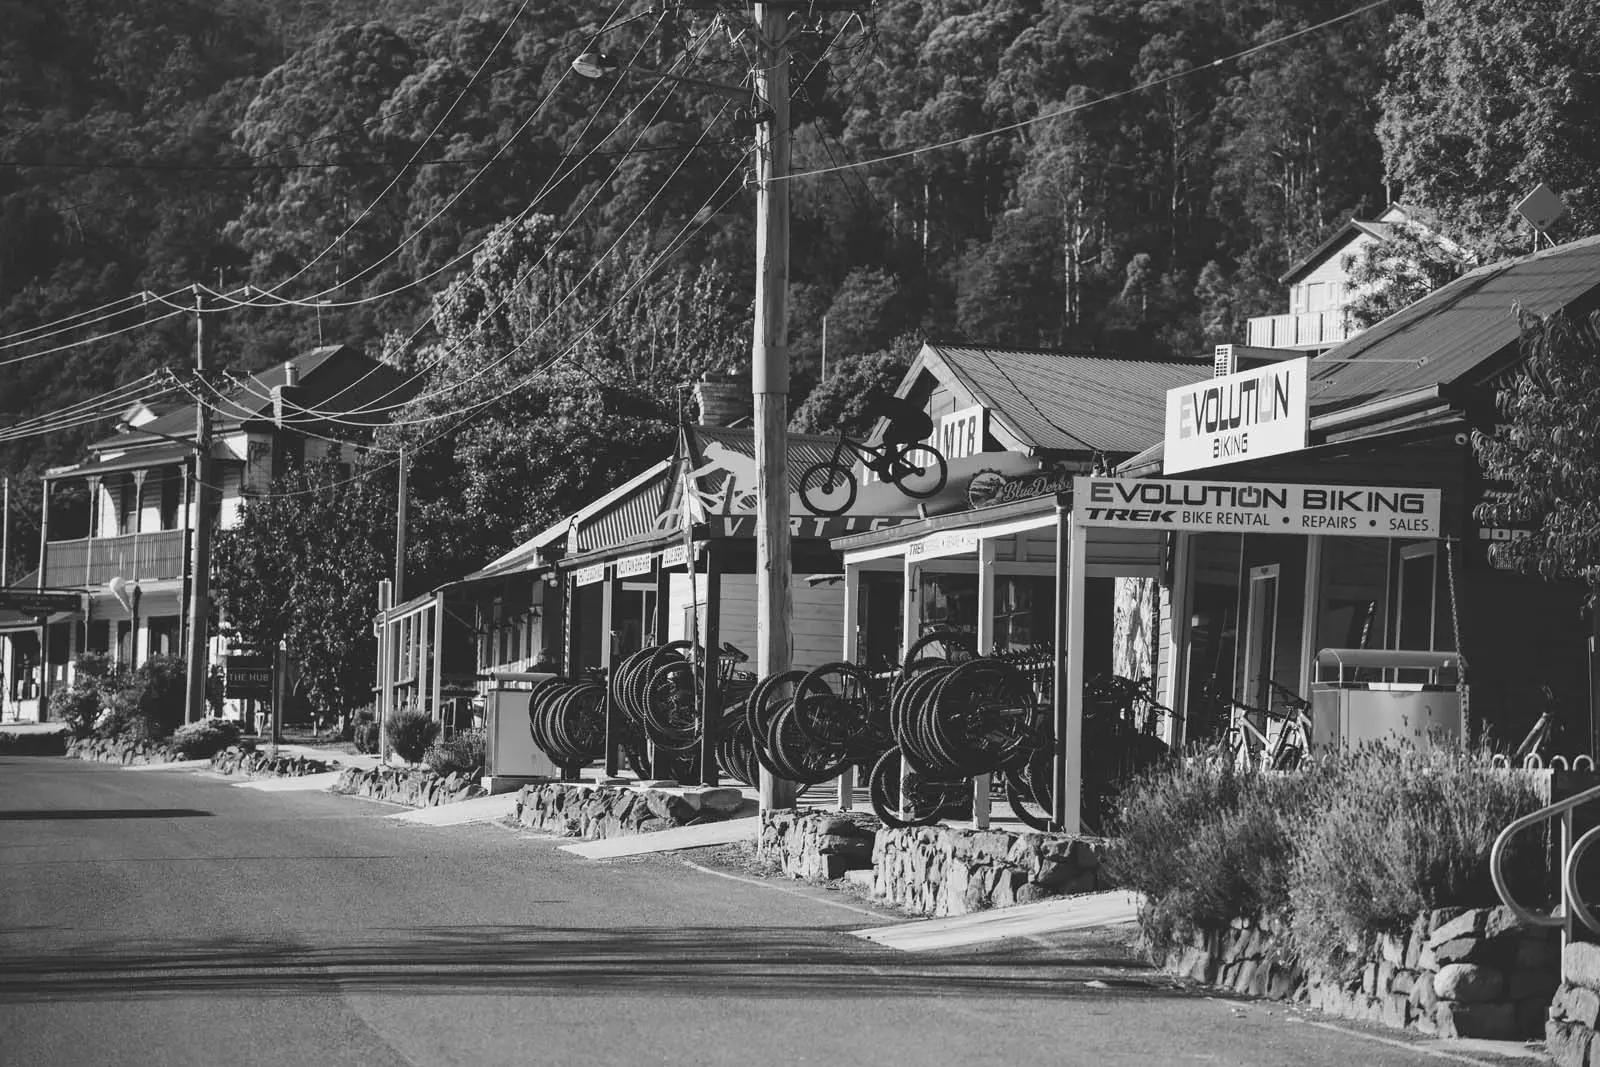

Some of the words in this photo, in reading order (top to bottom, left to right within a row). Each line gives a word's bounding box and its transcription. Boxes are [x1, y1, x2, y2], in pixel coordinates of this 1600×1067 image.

[1180, 371, 1290, 439] EVOLUTION
[943, 416, 977, 459] MTB
[1213, 433, 1248, 458] BIKING
[1091, 482, 1287, 509] EVOLUTION
[1303, 489, 1425, 514] BIKING
[724, 517, 921, 537] VRTIG
[1085, 508, 1177, 523] TREK
[1182, 511, 1213, 525] BIKE
[1217, 512, 1270, 526] RENTAL
[1302, 515, 1357, 529] REPAIRS
[1389, 518, 1429, 531] SALES
[228, 672, 248, 681] THE
[249, 672, 269, 682] HUB
